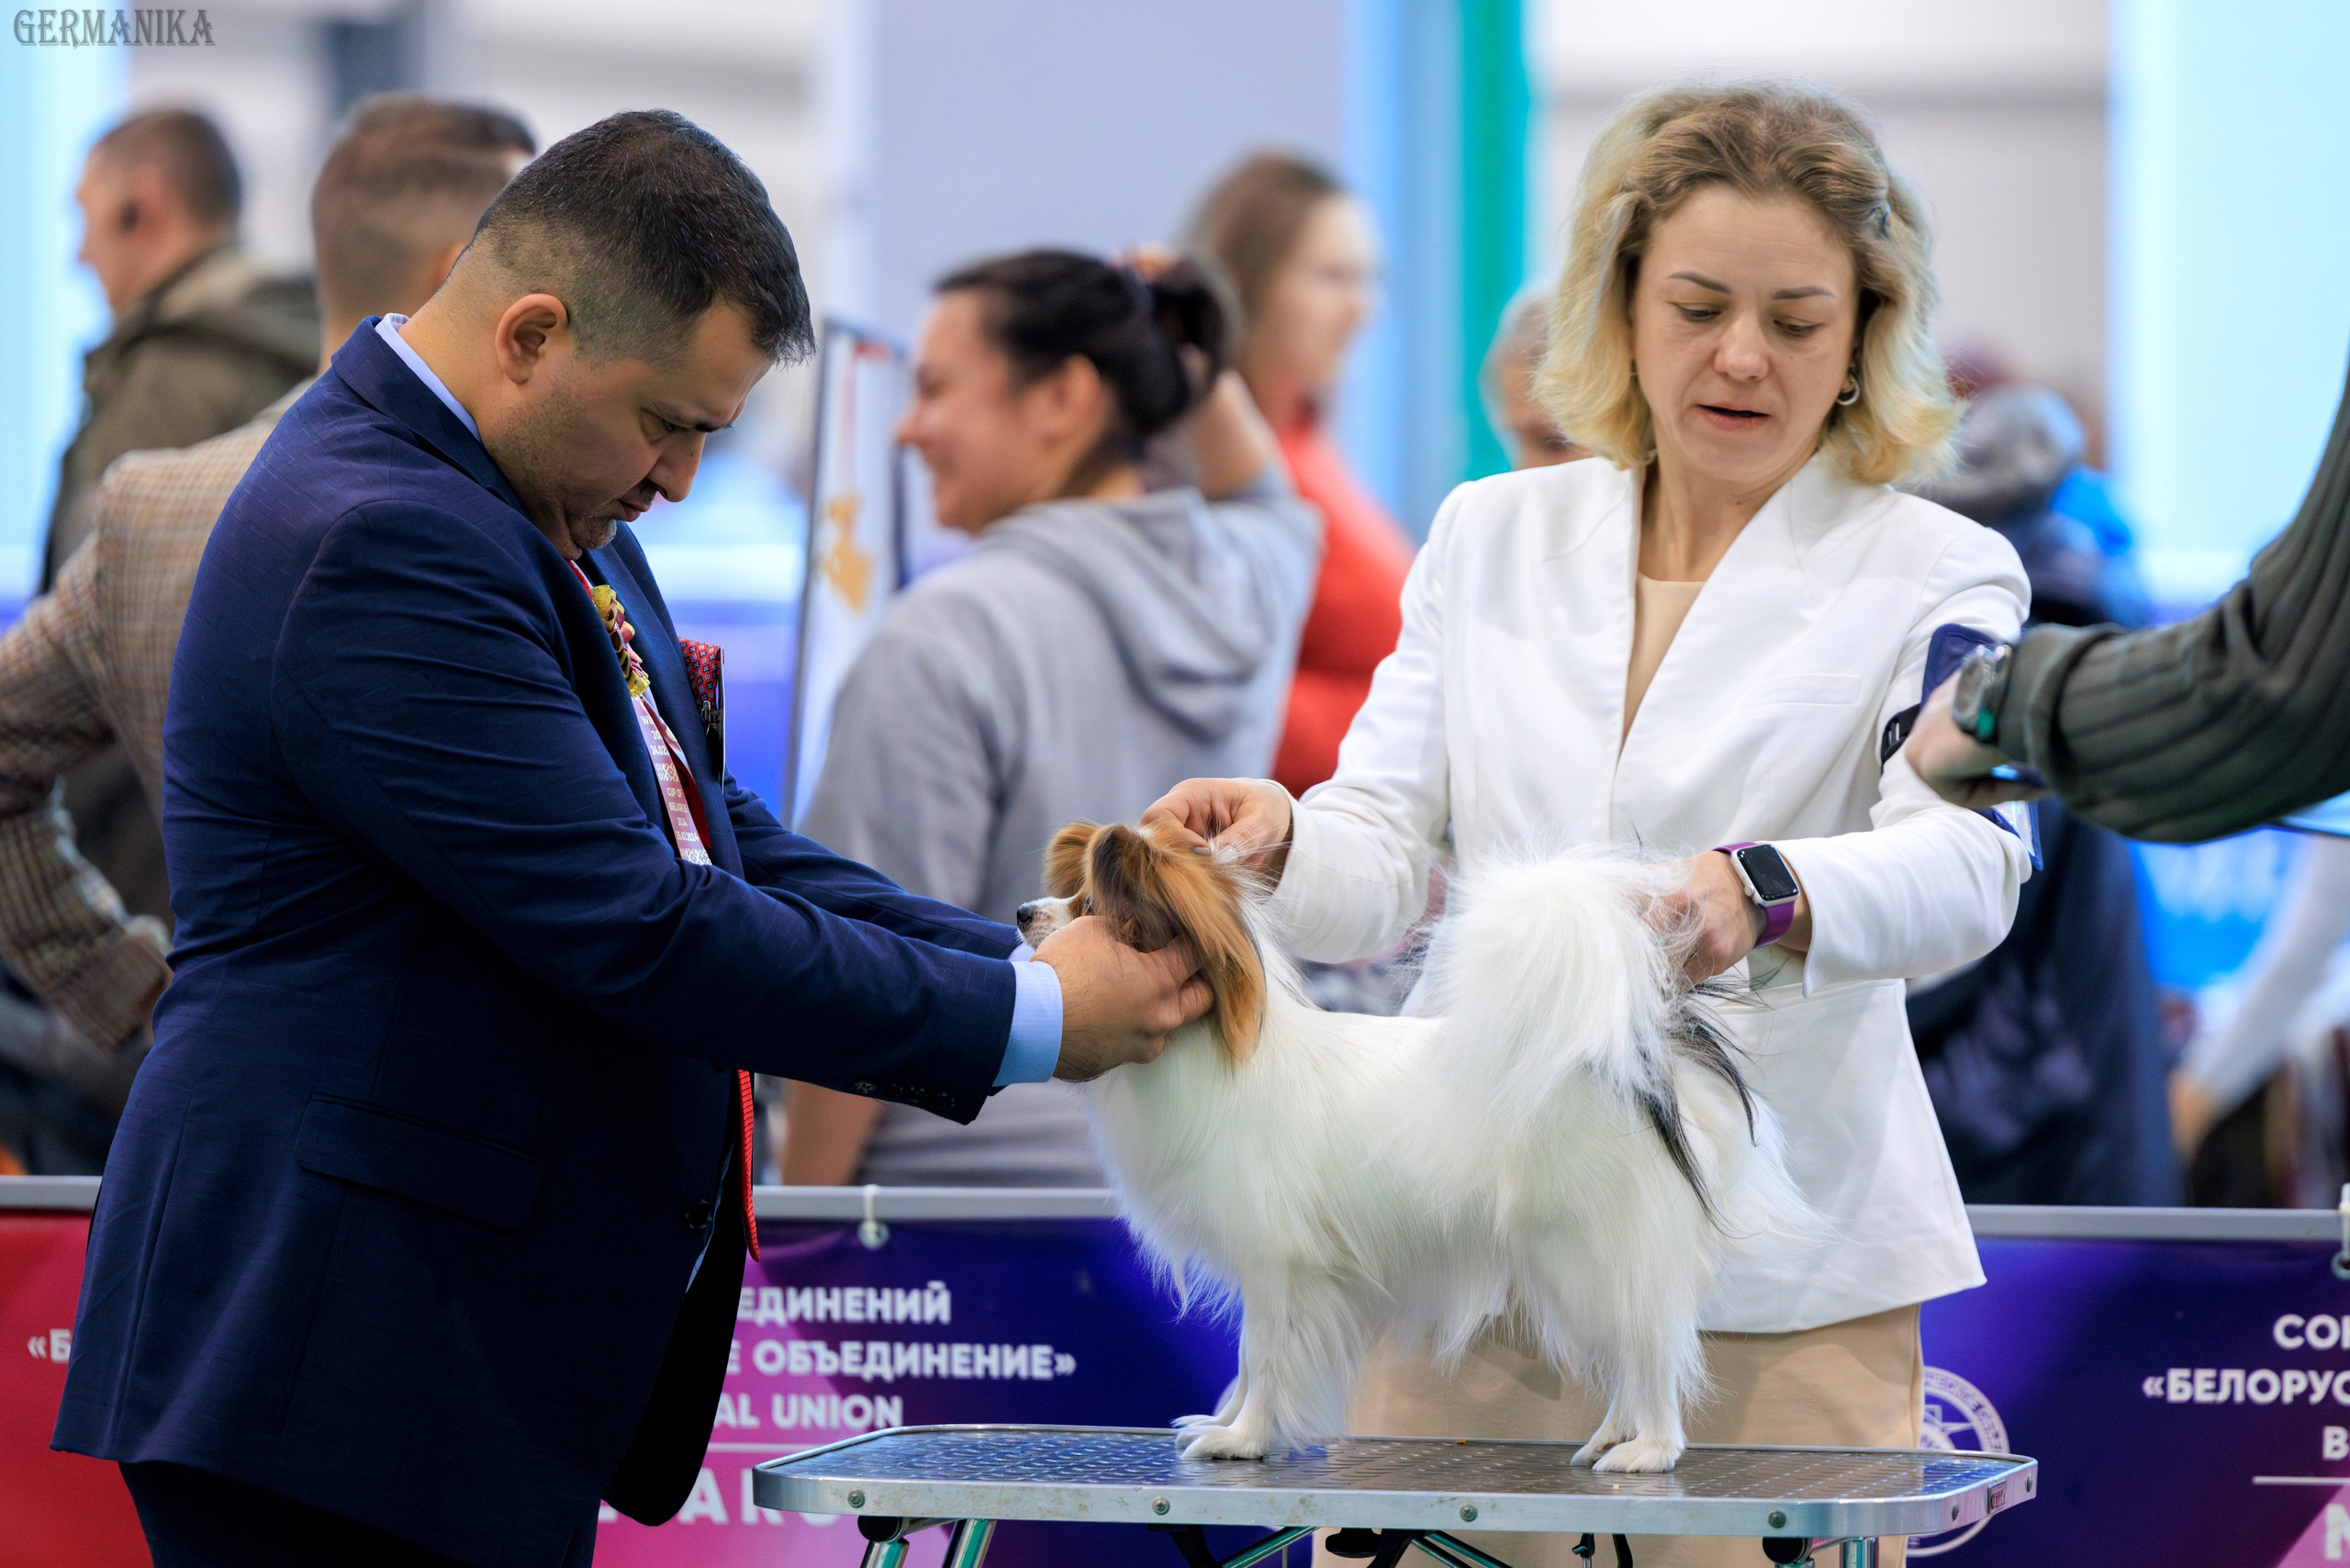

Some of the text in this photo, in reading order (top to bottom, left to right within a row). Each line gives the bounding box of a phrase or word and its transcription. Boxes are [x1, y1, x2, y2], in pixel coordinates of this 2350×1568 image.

[668, 801, 688, 813] BELARUS
[2272, 1313, 2350, 1351] СО
[753, 1338, 1077, 1383] ОБЪЕДИНЕНИЕ»
[771, 1393, 903, 1429] UNION
